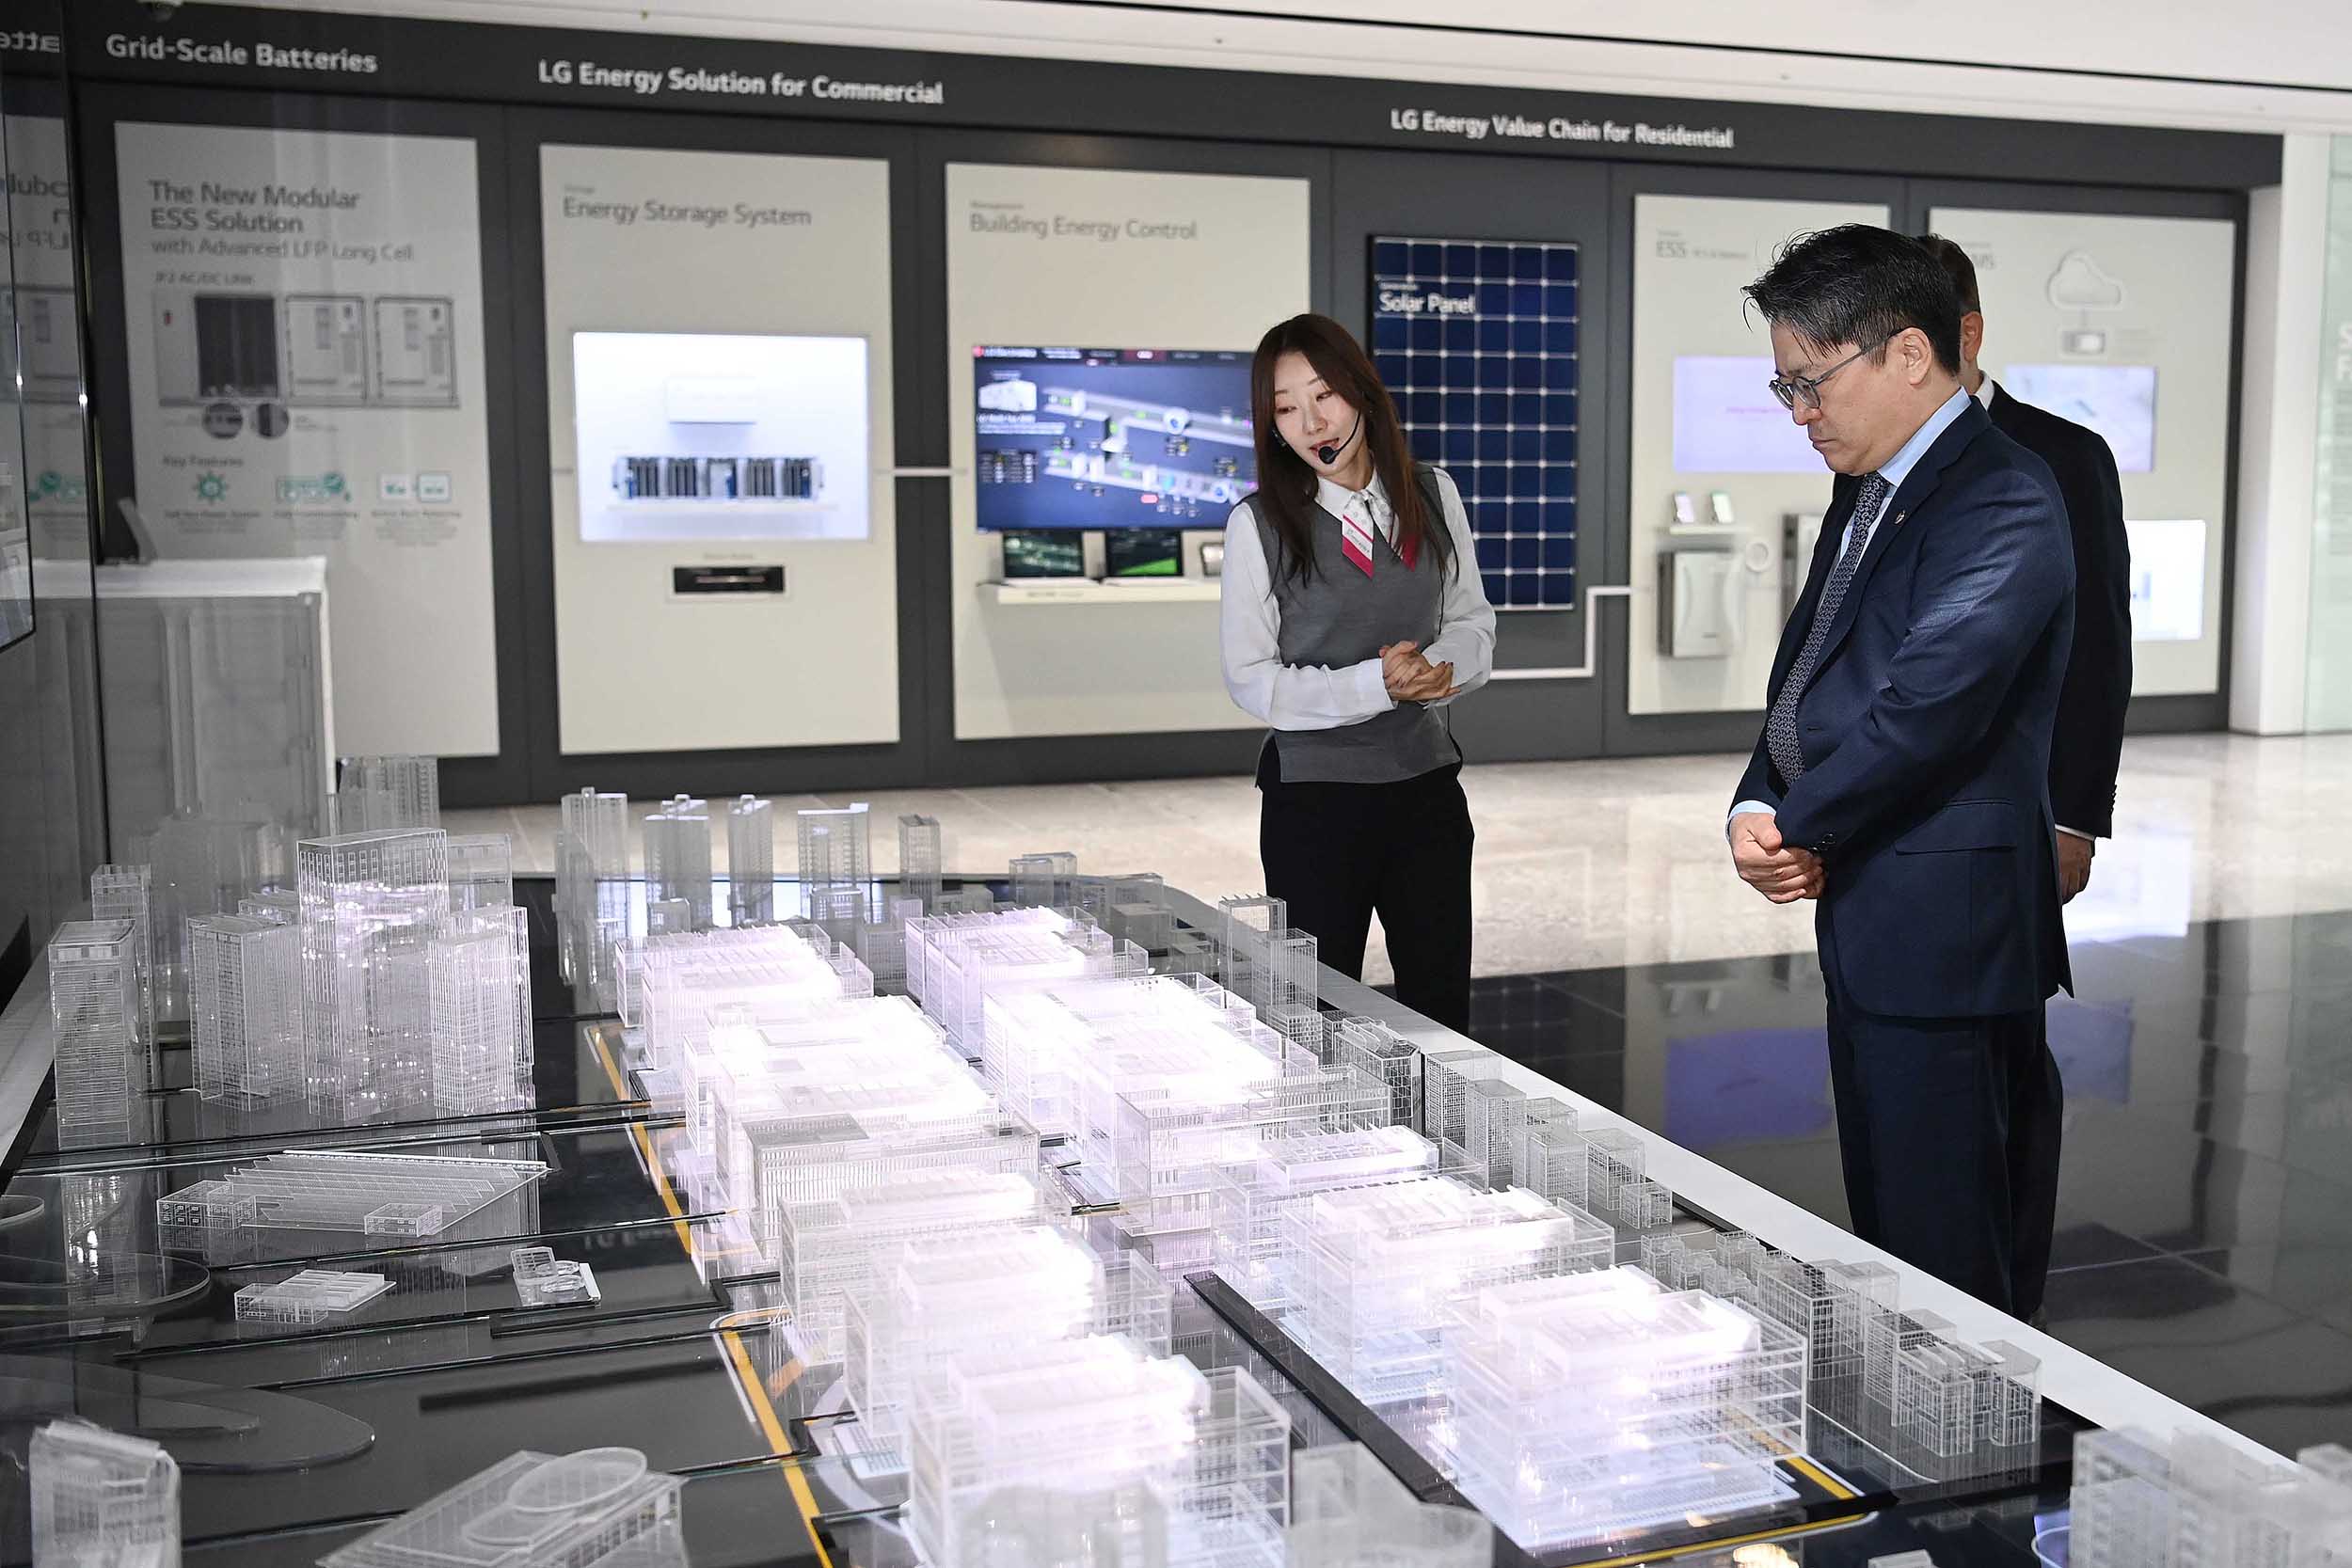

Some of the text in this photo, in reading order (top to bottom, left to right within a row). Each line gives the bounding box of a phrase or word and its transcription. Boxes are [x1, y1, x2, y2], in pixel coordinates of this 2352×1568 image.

[105, 34, 378, 73] Grid-Scale Batteries
[538, 59, 945, 104] LG Energy Solution for Commercial
[1391, 108, 1735, 149] LG Energy Value Chain for Residential
[148, 179, 361, 210] The New Modular
[150, 206, 305, 234] ESS Solution
[564, 195, 813, 229] Energy Storage System
[970, 213, 1199, 242] Building Energy Control
[151, 237, 196, 256] with
[198, 238, 287, 260] Advanced
[1379, 291, 1476, 314] Solar Panel
